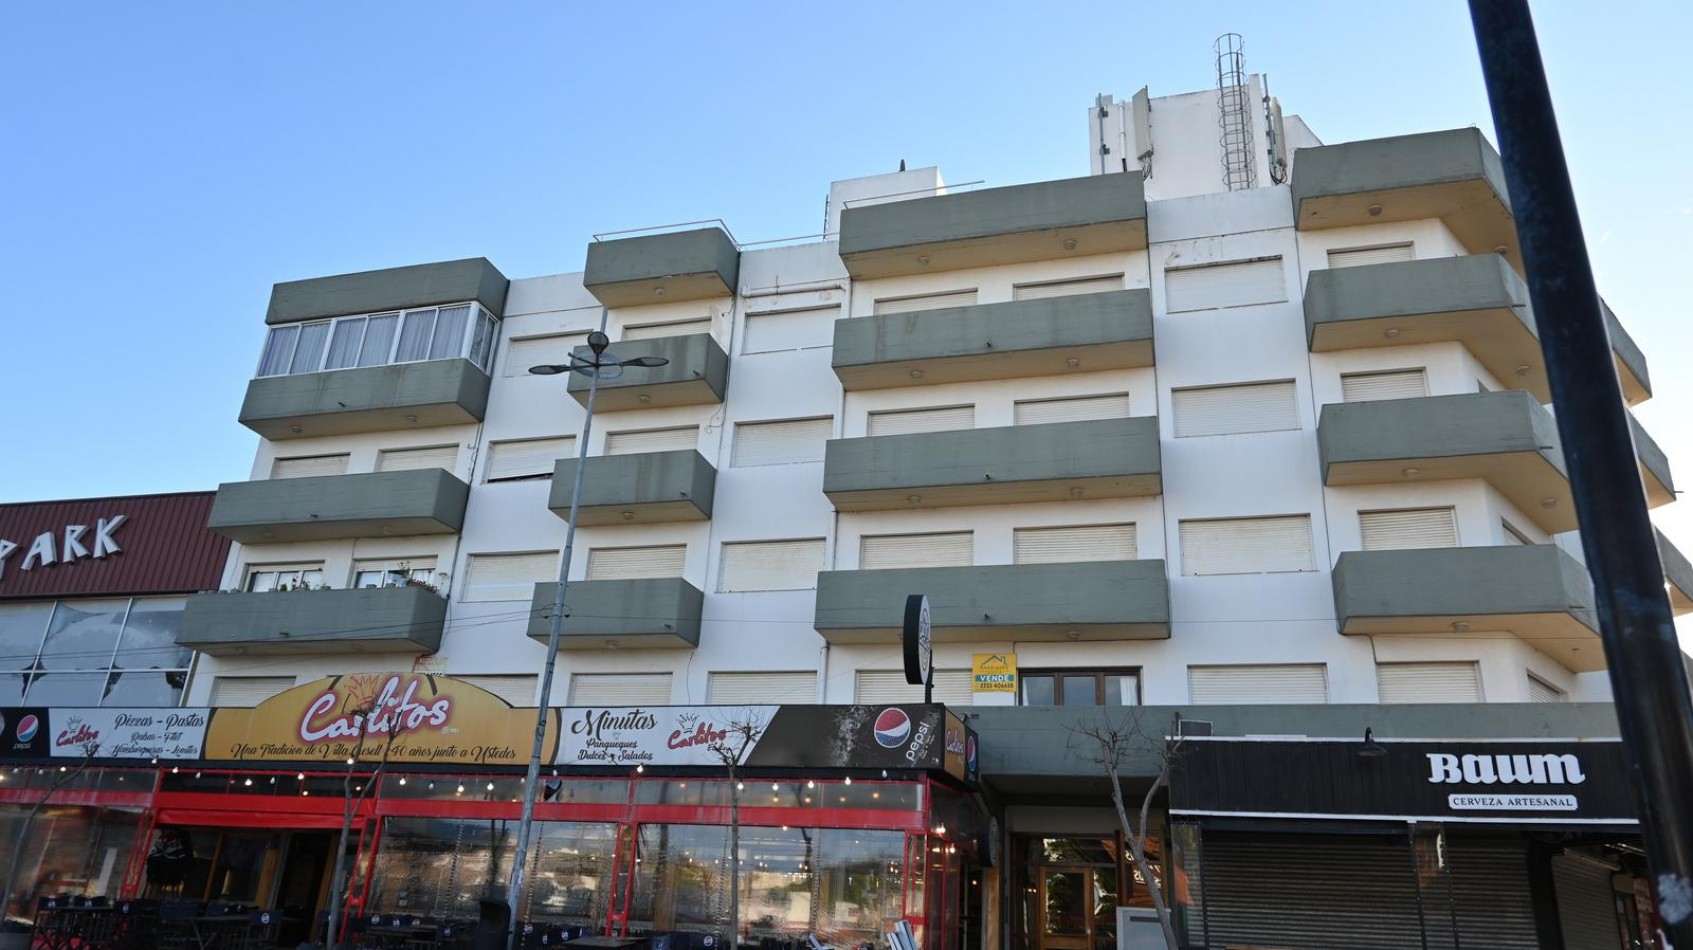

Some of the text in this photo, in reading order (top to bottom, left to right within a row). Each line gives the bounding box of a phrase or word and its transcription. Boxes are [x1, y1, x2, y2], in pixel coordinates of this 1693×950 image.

[0, 514, 128, 579] PARK
[301, 676, 450, 742] Carlitos
[114, 713, 153, 730] Pizzas
[165, 713, 204, 731] Pastas
[571, 709, 657, 741] Minutas
[130, 732, 156, 745] Rabas
[586, 738, 638, 751] Panqueques
[667, 722, 727, 750] Carlitos
[906, 721, 930, 762] pepsi
[230, 744, 257, 760] Una
[304, 744, 315, 756] de
[318, 744, 348, 759] Villa
[408, 746, 431, 757] años
[430, 746, 457, 761] junto
[460, 749, 468, 757] a
[471, 746, 516, 763] Ustedes
[577, 749, 606, 761] Dulces
[618, 749, 653, 762] Salados
[1426, 753, 1585, 784] Baum
[1453, 797, 1573, 807] CERVEZA ARTESANAL
